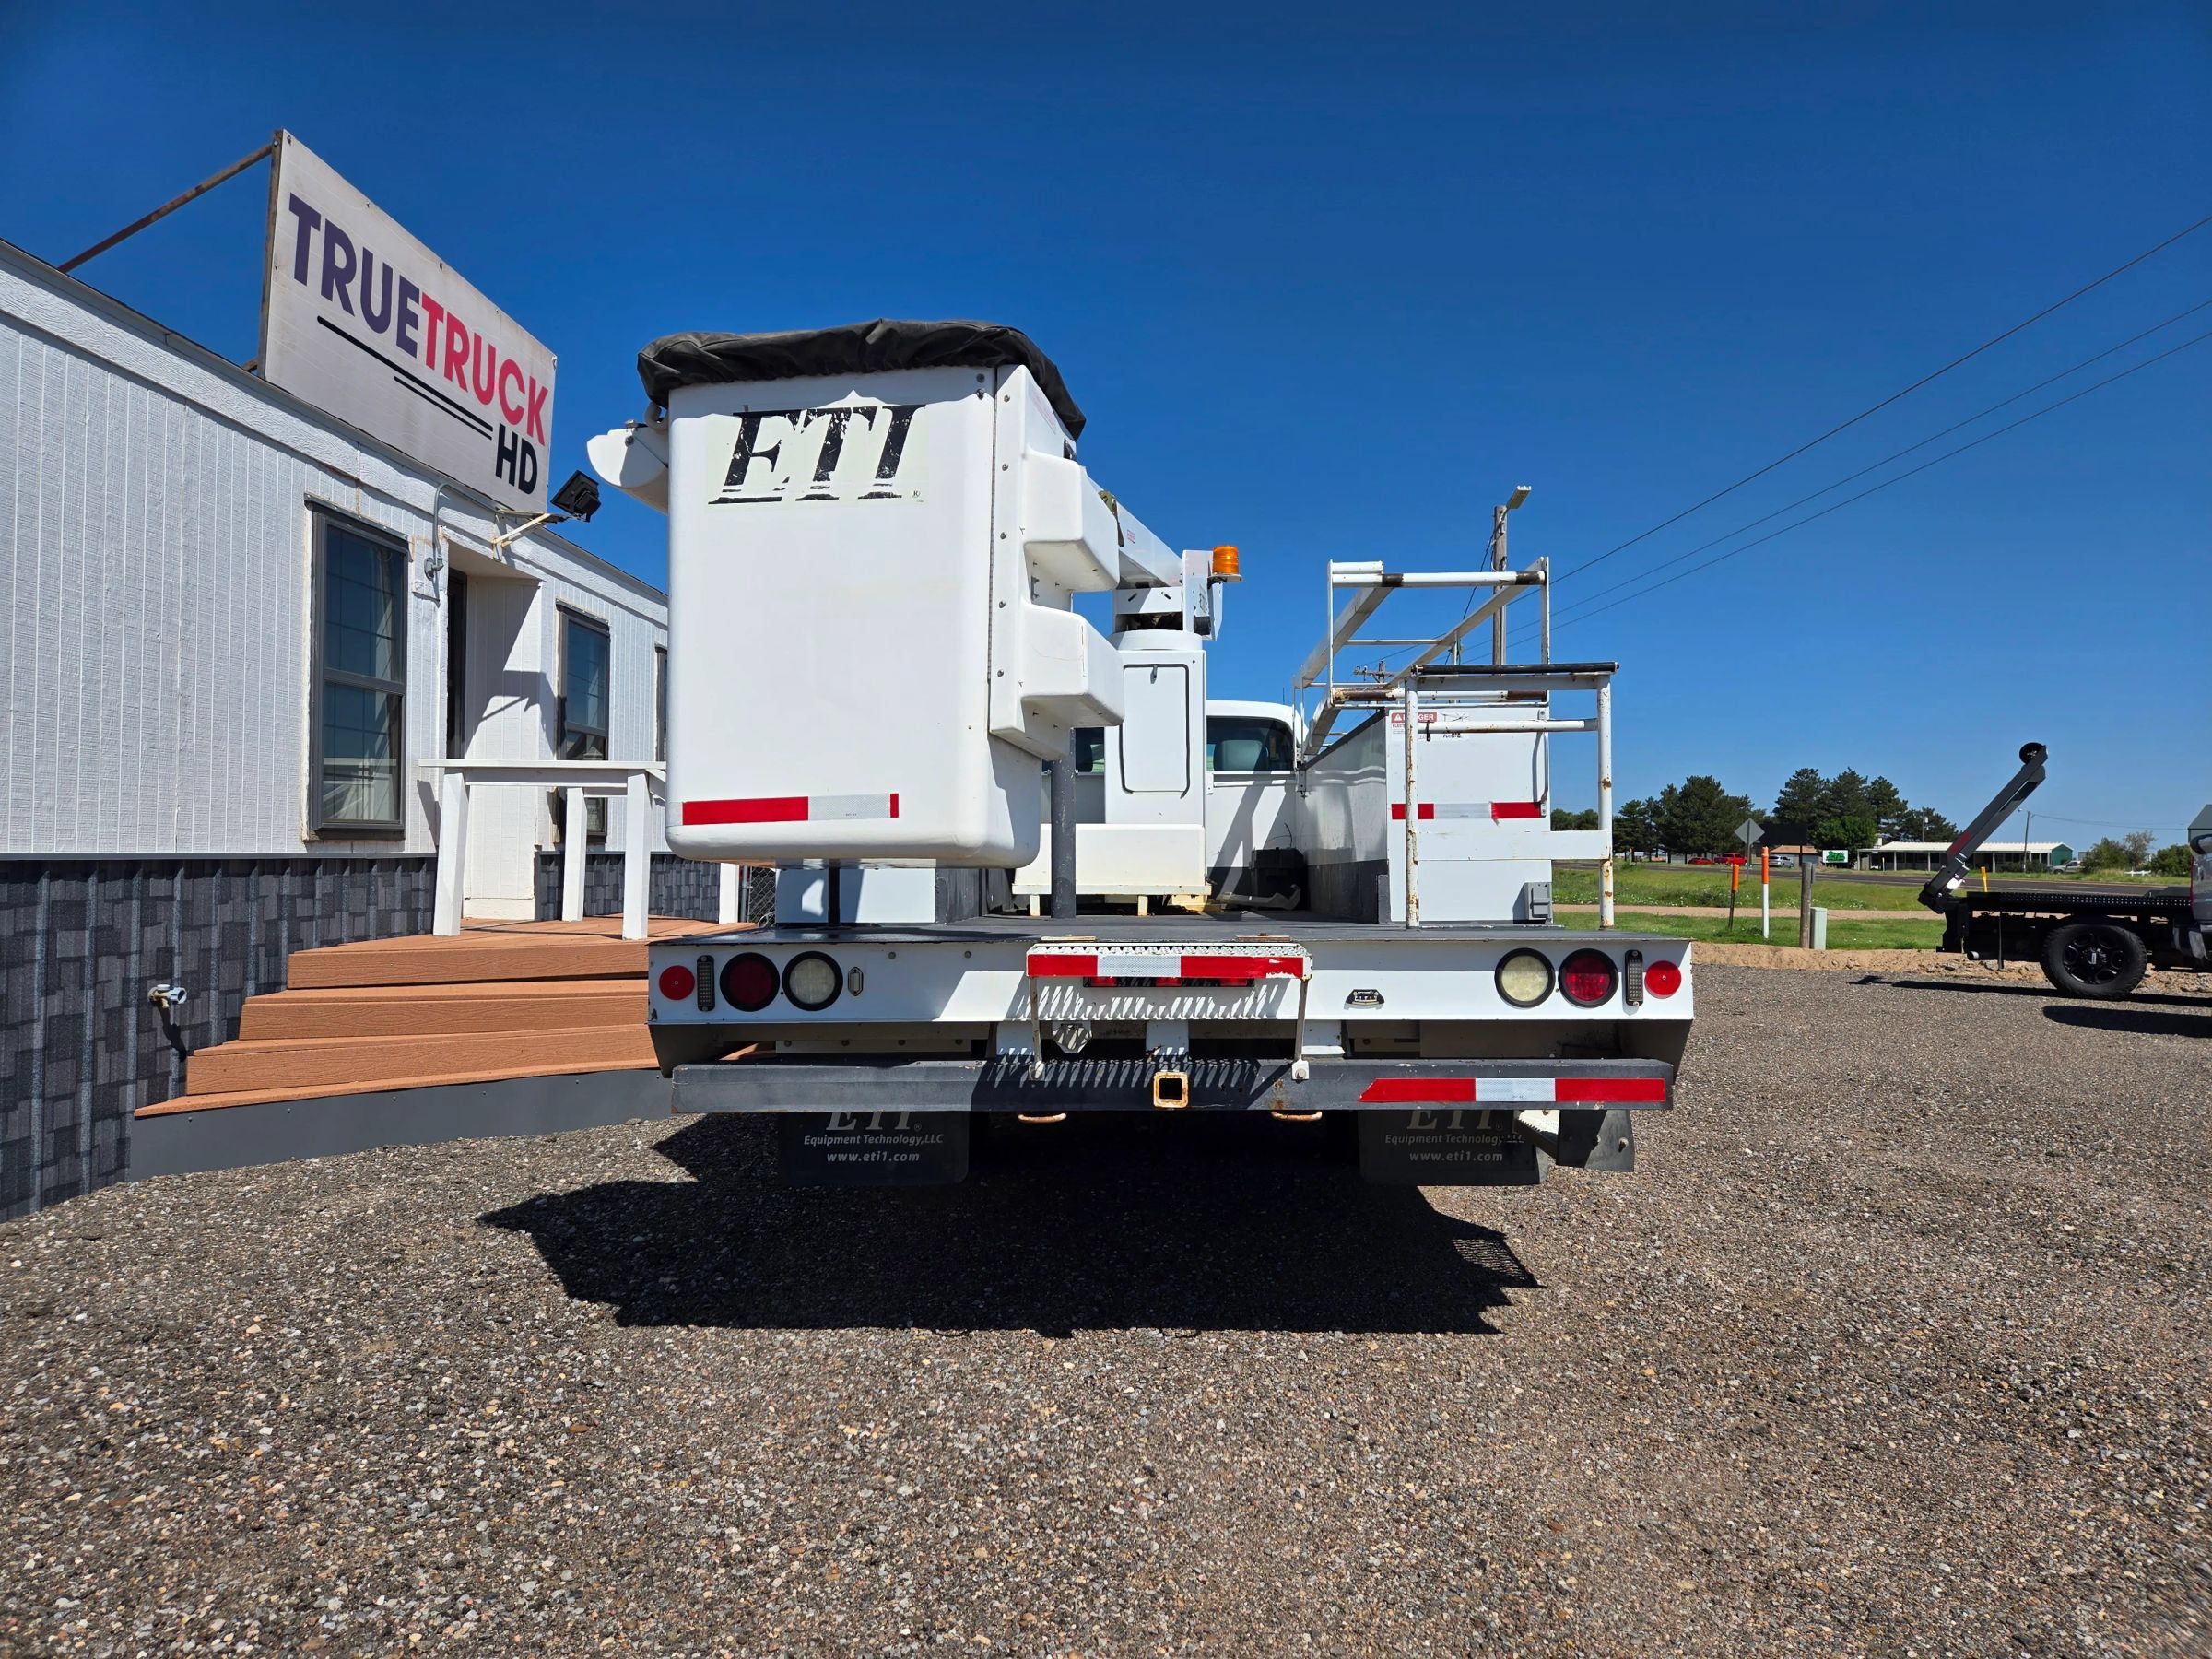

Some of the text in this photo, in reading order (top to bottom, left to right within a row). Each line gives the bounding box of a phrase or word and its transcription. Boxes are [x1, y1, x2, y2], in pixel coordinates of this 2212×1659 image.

[495, 423, 538, 495] HD
[708, 405, 926, 504] ETI
[804, 1135, 861, 1147] Equipment
[1384, 1135, 1442, 1146] Equipment
[827, 1151, 920, 1162] www.eti1.com
[1409, 1150, 1503, 1162] www.eti1.com
